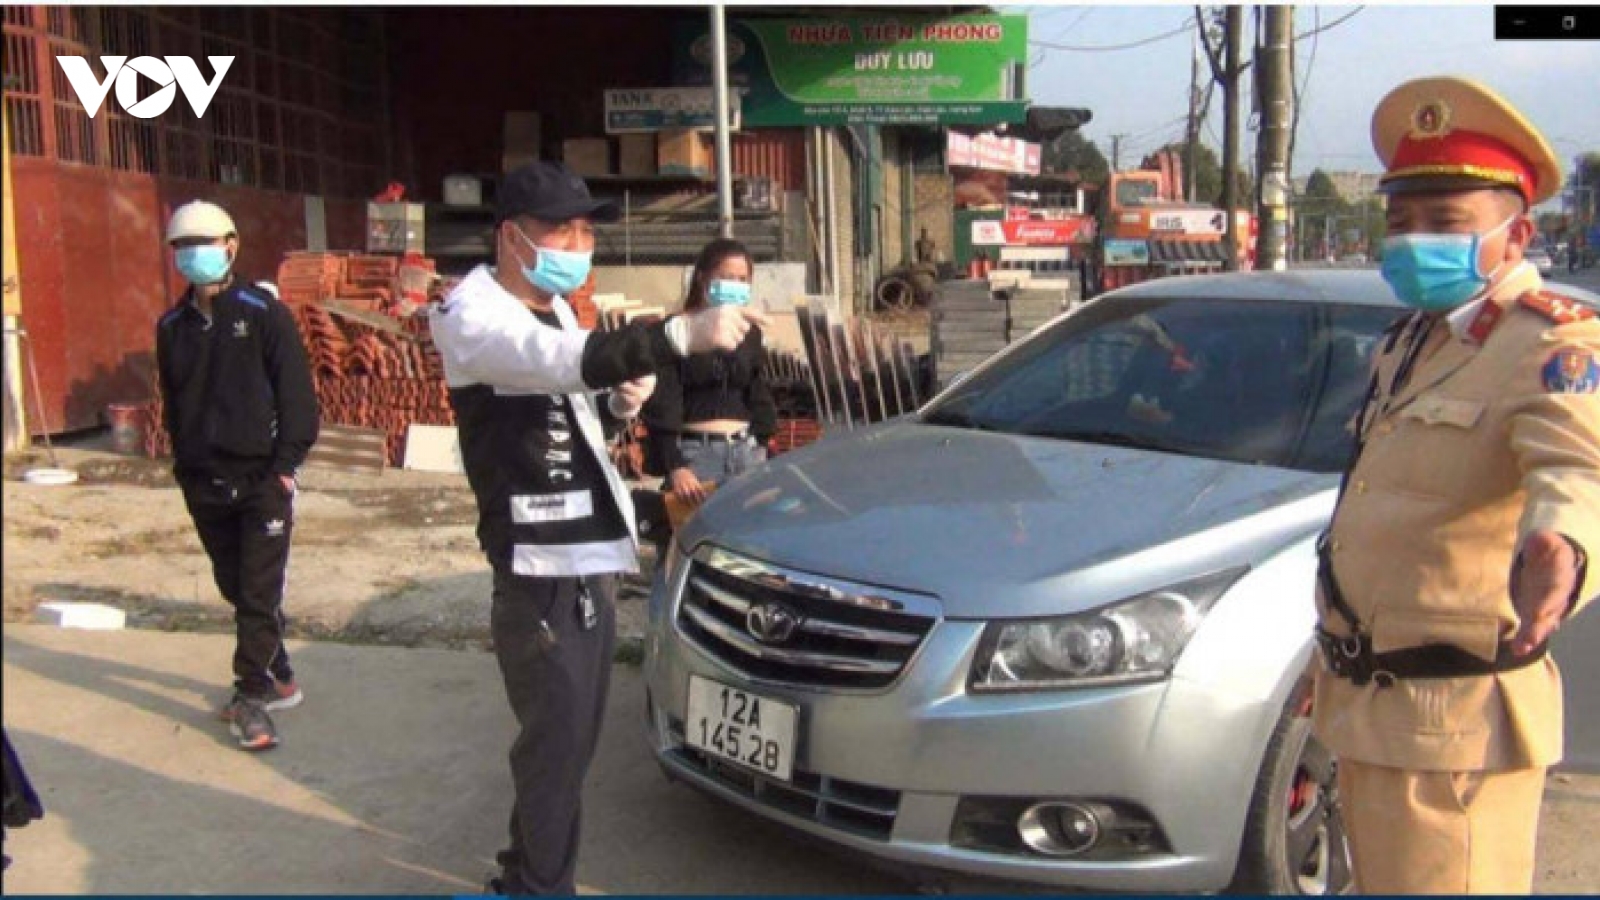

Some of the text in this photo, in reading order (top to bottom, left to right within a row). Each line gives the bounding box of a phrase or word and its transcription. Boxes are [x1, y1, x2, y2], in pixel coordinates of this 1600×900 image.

[922, 23, 1002, 42] PHONG
[854, 52, 892, 70] DUY
[721, 688, 761, 728] 12A
[699, 716, 779, 772] 145.28
